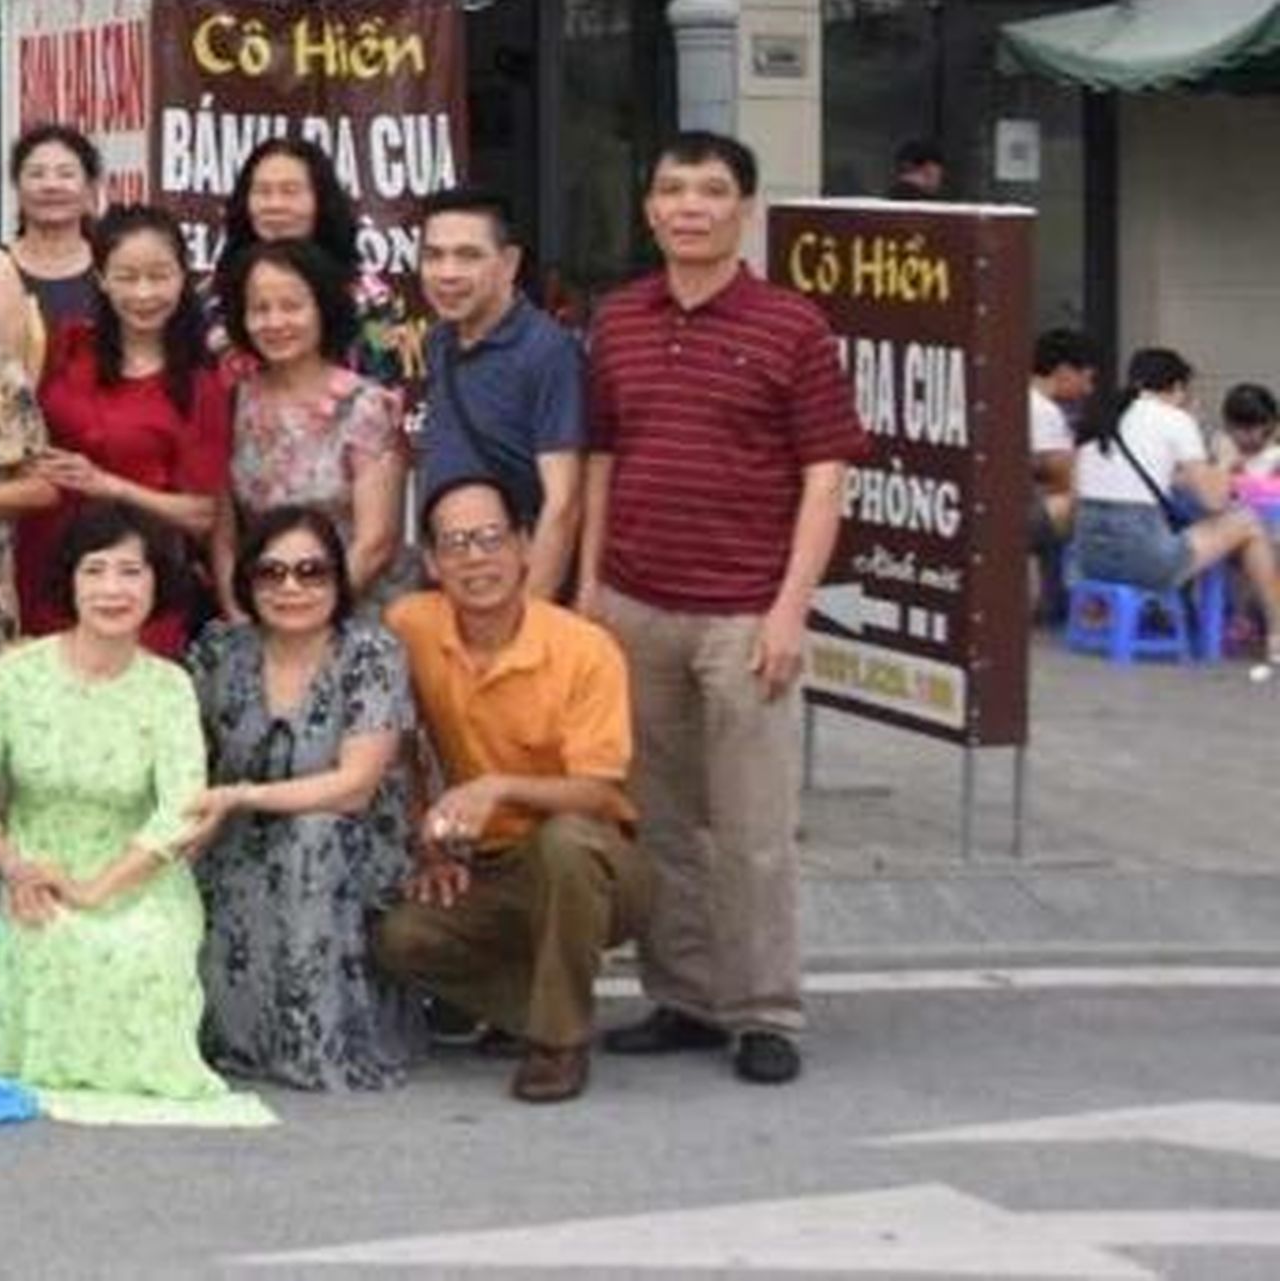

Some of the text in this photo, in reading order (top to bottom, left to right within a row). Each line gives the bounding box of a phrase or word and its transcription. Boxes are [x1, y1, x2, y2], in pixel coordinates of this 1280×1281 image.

[192, 12, 426, 78] Cô Hiền
[369, 113, 456, 198] CUA
[791, 232, 949, 303] Cô Hiền
[903, 341, 968, 447] CUA
[840, 457, 961, 538] PHÒNG
